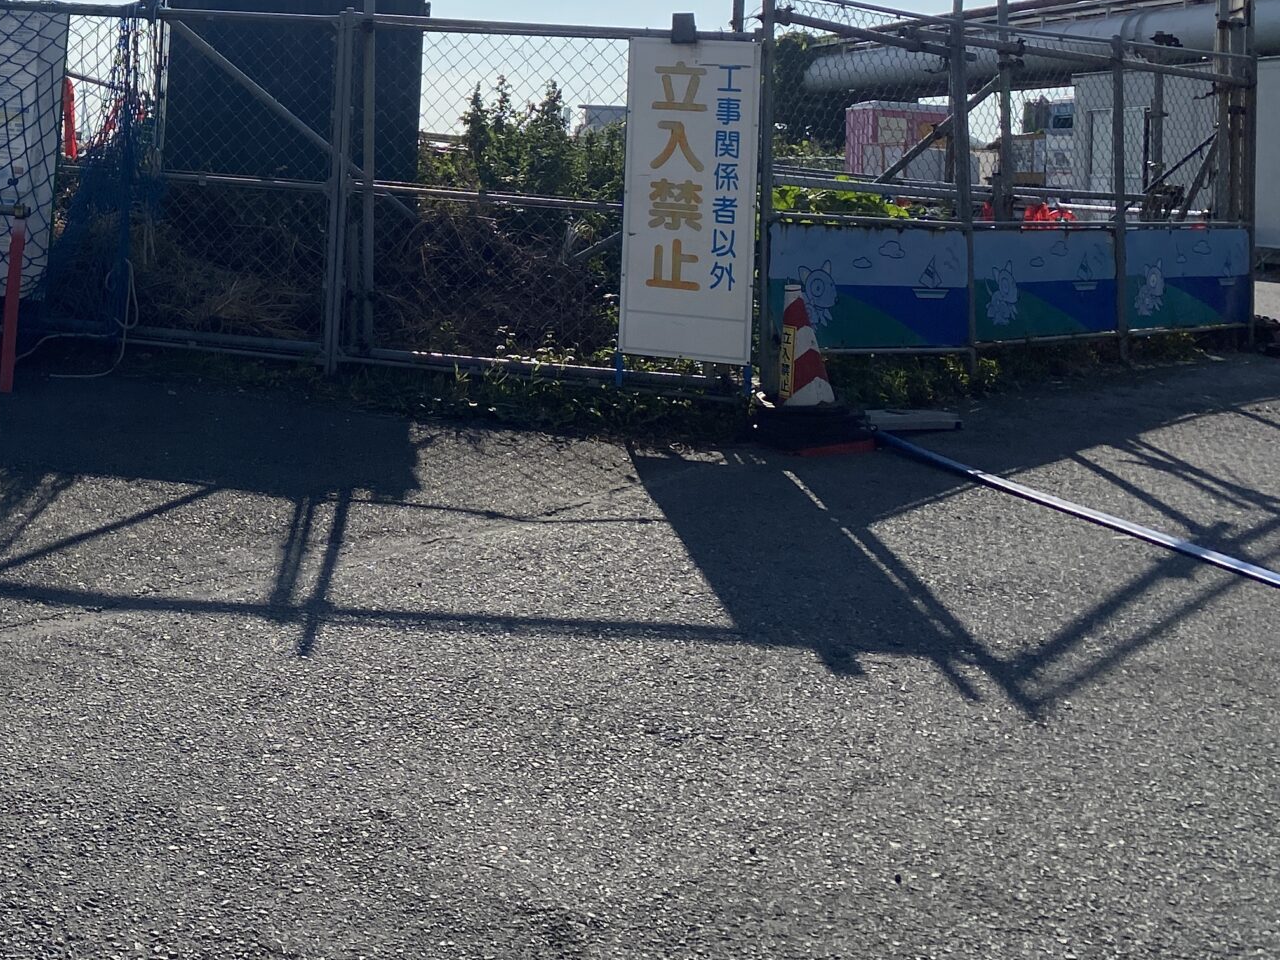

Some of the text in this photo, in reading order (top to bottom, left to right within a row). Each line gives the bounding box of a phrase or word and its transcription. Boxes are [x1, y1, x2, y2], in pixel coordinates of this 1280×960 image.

[645, 61, 708, 291] 立入禁止
[710, 64, 742, 291] 工事関係者以外
[781, 332, 792, 392] 立入禁止
